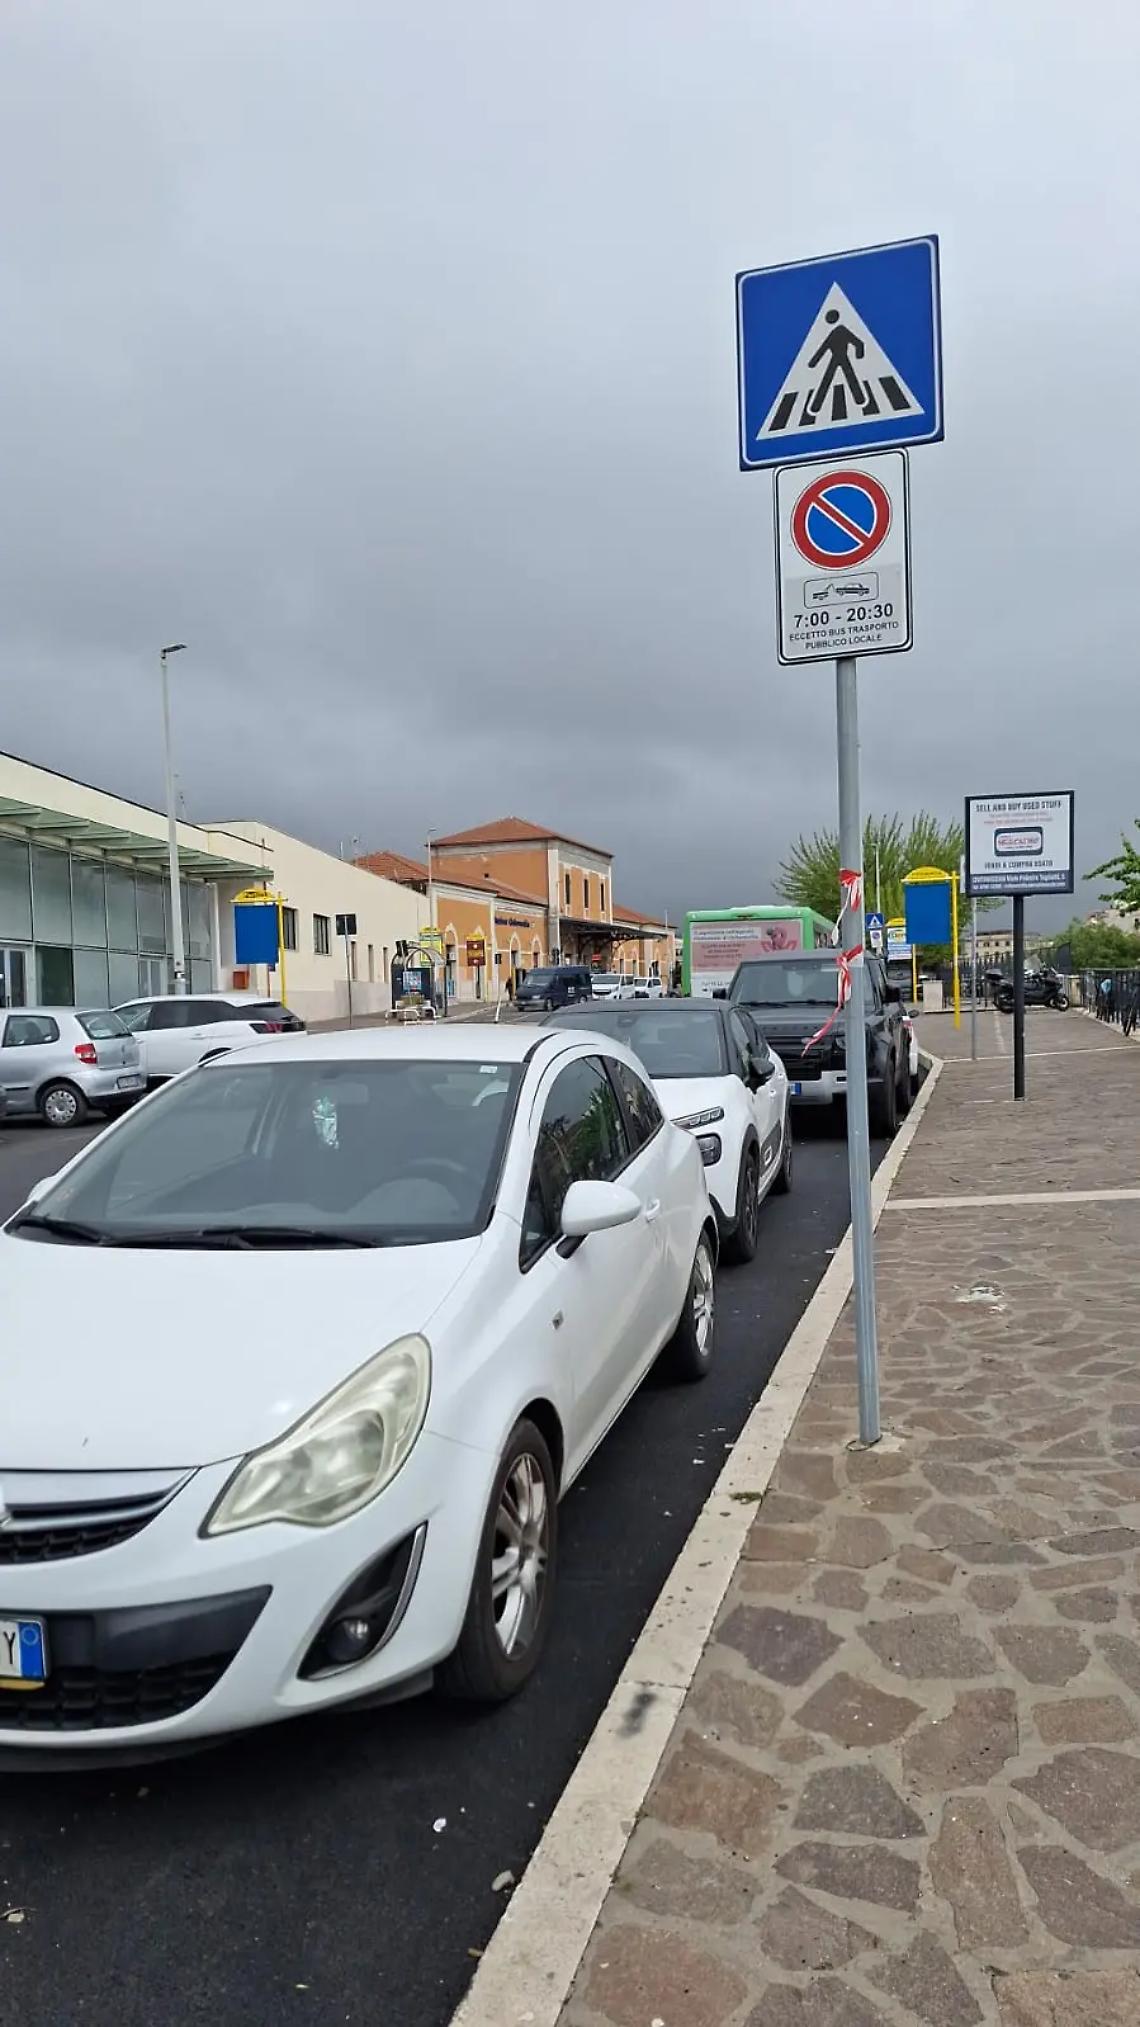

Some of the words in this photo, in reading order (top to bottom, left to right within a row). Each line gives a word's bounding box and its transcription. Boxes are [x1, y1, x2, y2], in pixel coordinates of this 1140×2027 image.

[794, 611, 829, 628] 7:00
[846, 603, 893, 622] 20:30
[789, 629, 827, 641] ECCETTO
[829, 627, 846, 636] BUS
[848, 621, 899, 634] TRASPORTO
[805, 638, 847, 649] PUBBLICO
[849, 634, 882, 645] LOCALE
